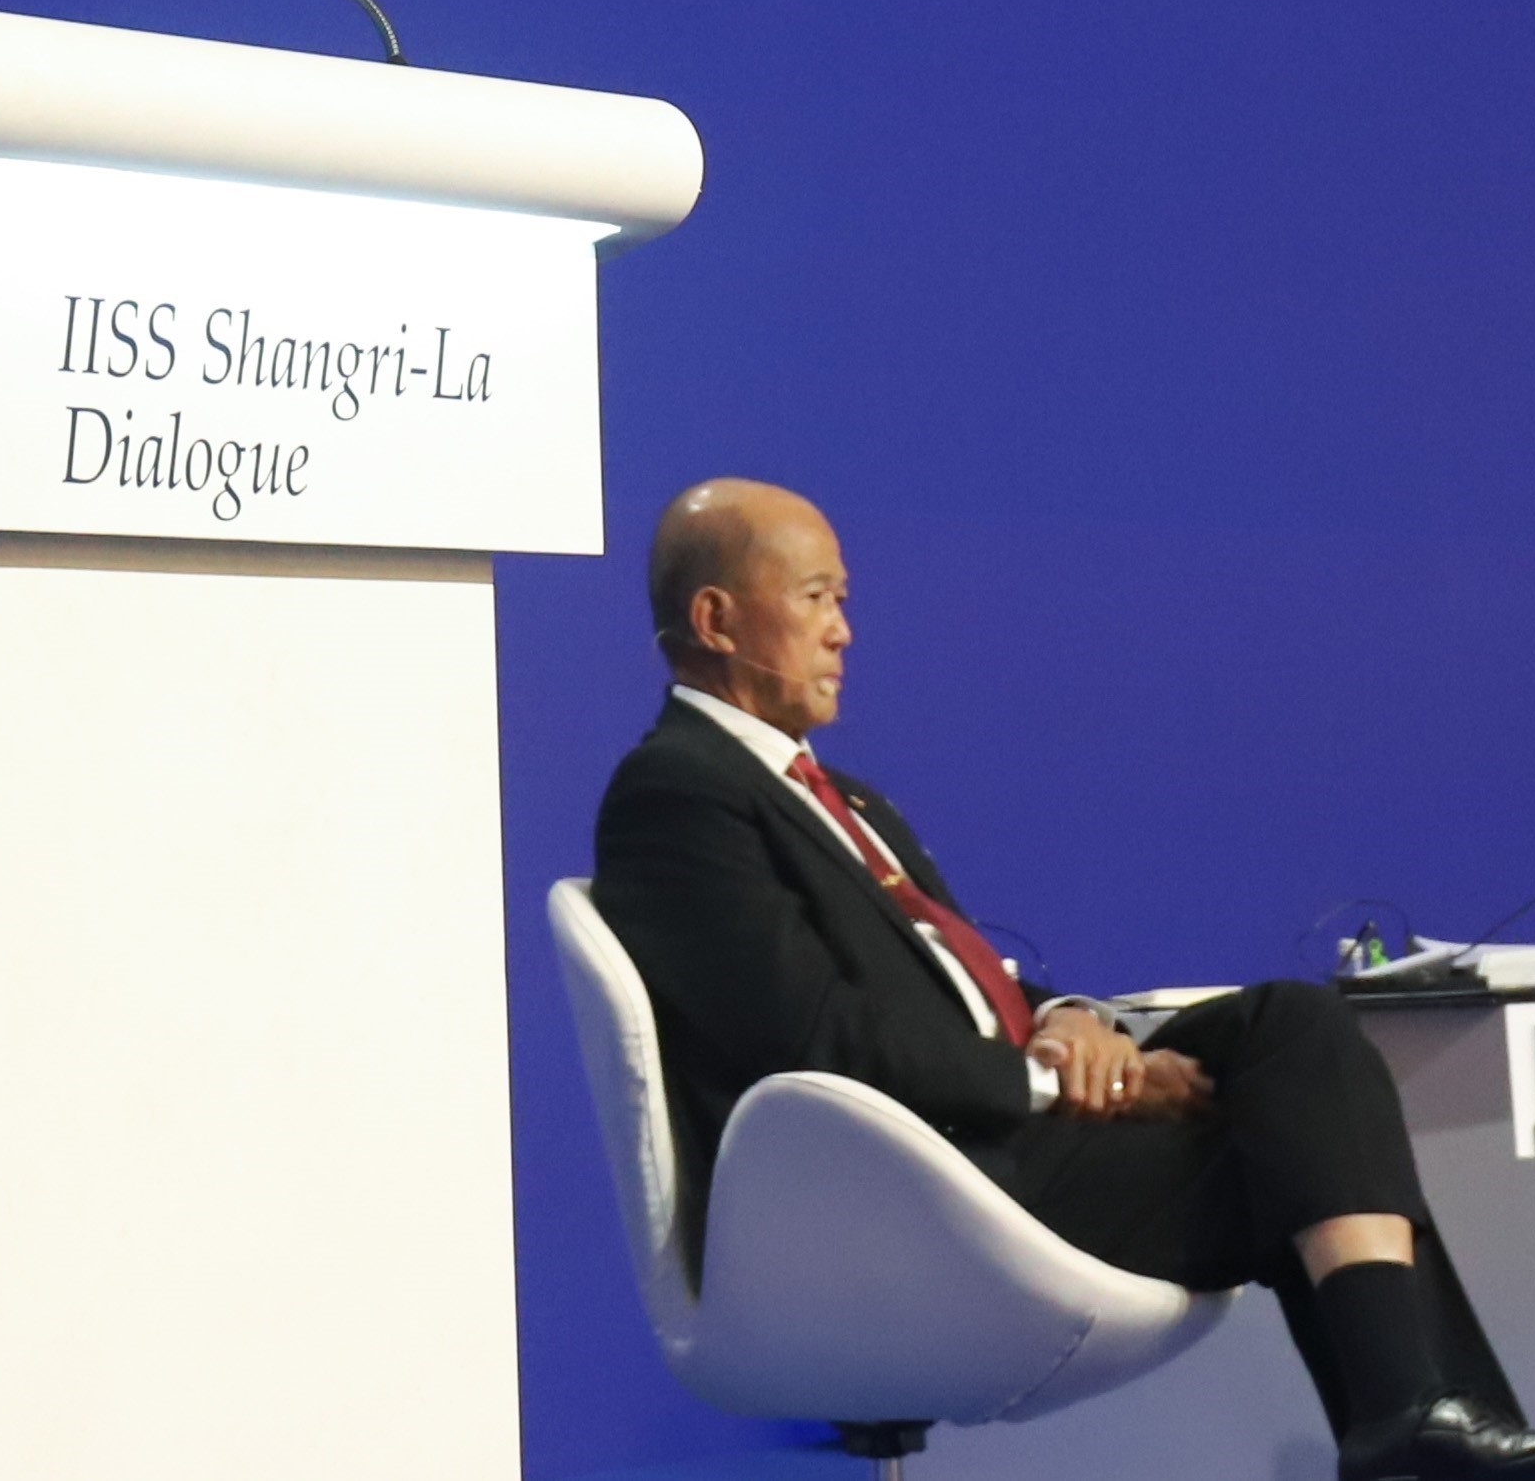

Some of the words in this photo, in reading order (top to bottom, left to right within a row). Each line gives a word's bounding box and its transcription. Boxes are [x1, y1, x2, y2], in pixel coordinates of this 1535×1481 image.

[59, 296, 177, 381] IISS
[202, 307, 493, 421] Shangri-La
[62, 406, 310, 521] Dialogue
